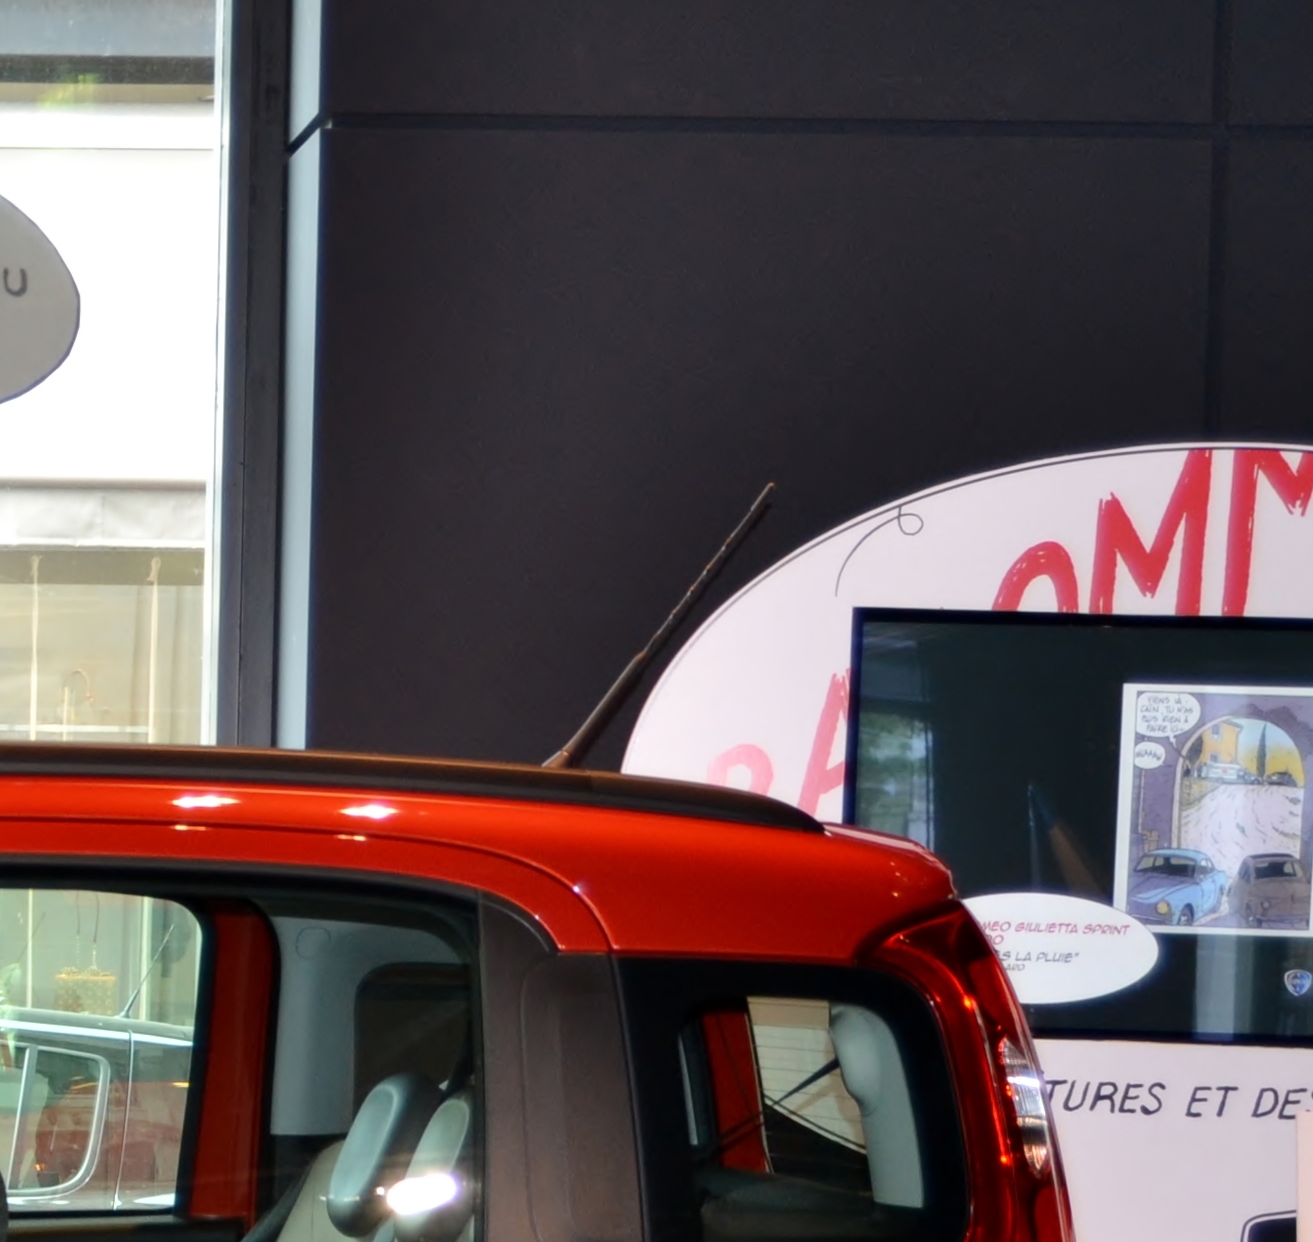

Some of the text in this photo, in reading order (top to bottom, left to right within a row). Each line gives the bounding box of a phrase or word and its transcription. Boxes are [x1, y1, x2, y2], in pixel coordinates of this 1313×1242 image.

[981, 920, 1131, 936] MEO GIULIETTA SPRINT
[1015, 951, 1032, 962] LA
[1045, 1079, 1313, 1120] TURES ET DE
